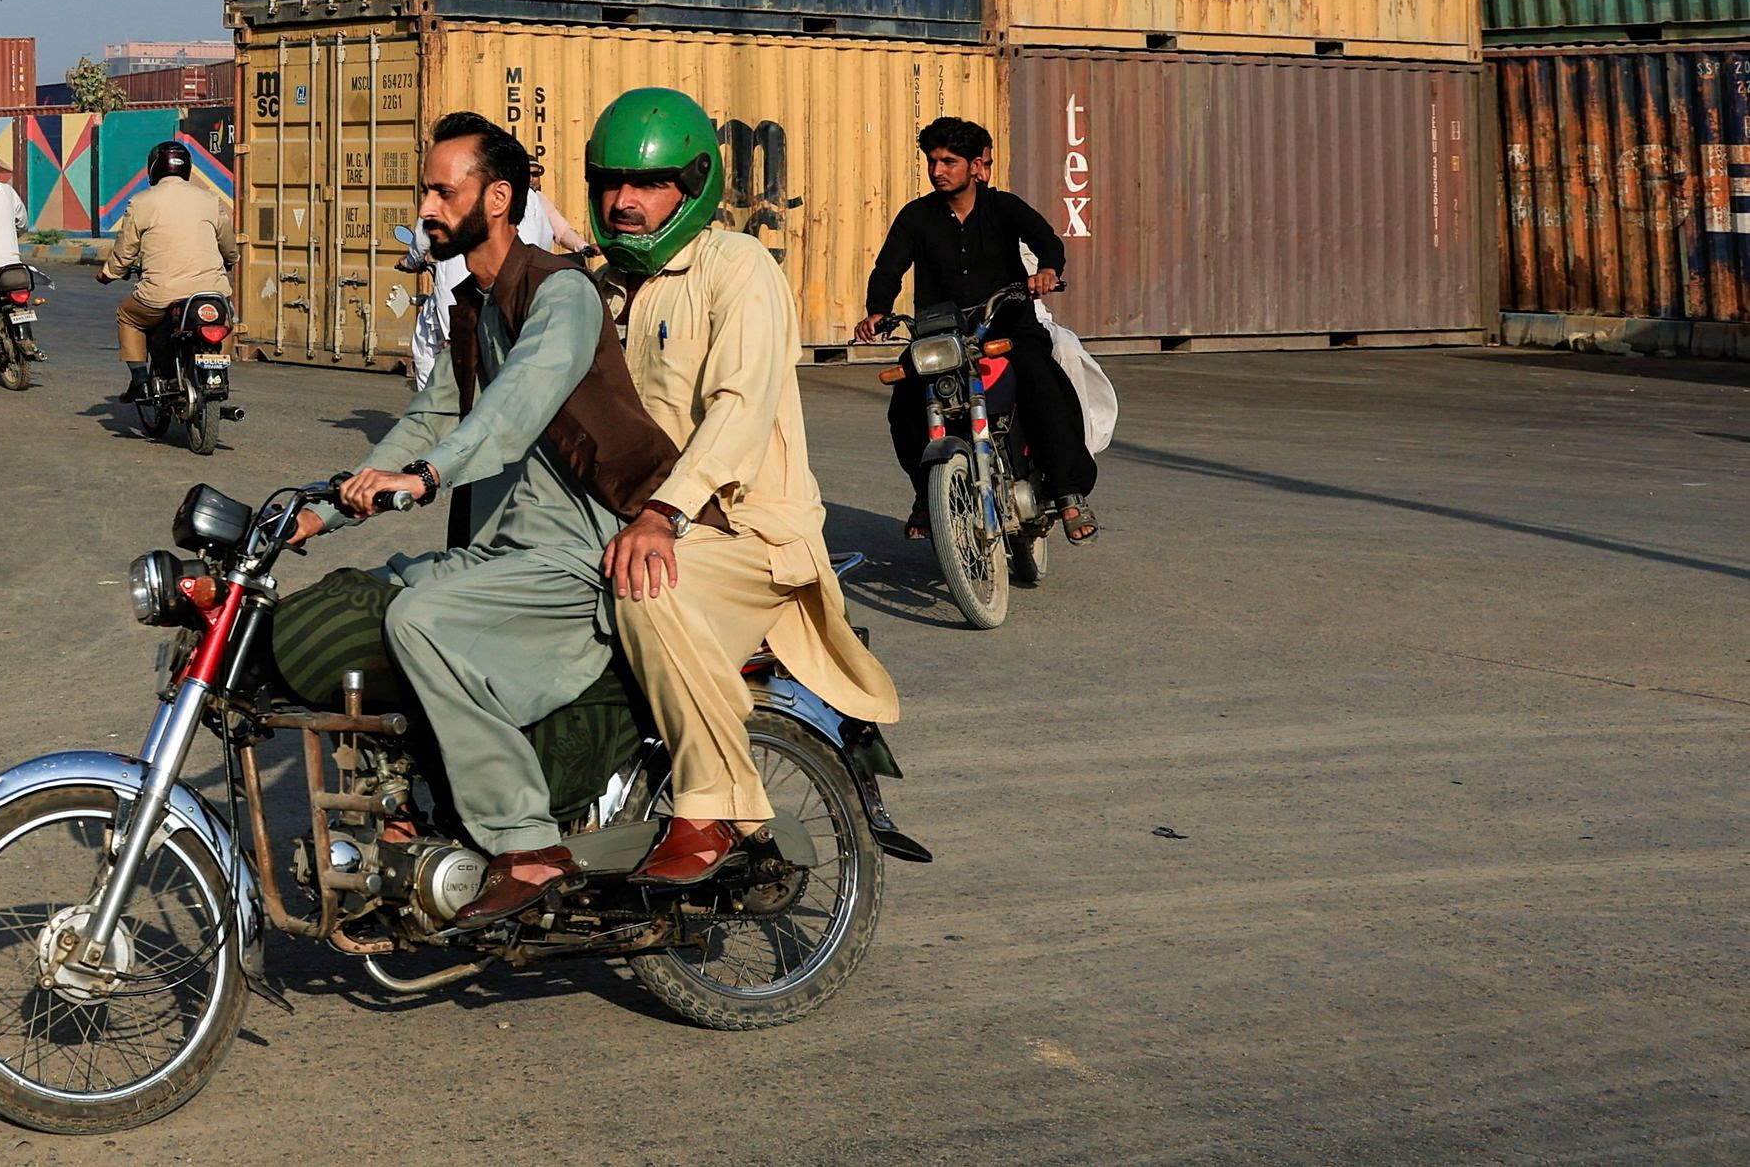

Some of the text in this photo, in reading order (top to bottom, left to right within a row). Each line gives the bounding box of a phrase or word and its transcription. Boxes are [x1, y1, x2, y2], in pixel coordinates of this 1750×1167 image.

[382, 73, 413, 89] 654273
[913, 63, 921, 119] MSCU
[382, 94, 402, 110] 22G1
[1062, 93, 1092, 237] tex
[346, 169, 363, 184] TARE
[345, 207, 358, 222] NET
[446, 883, 468, 892] UNION
